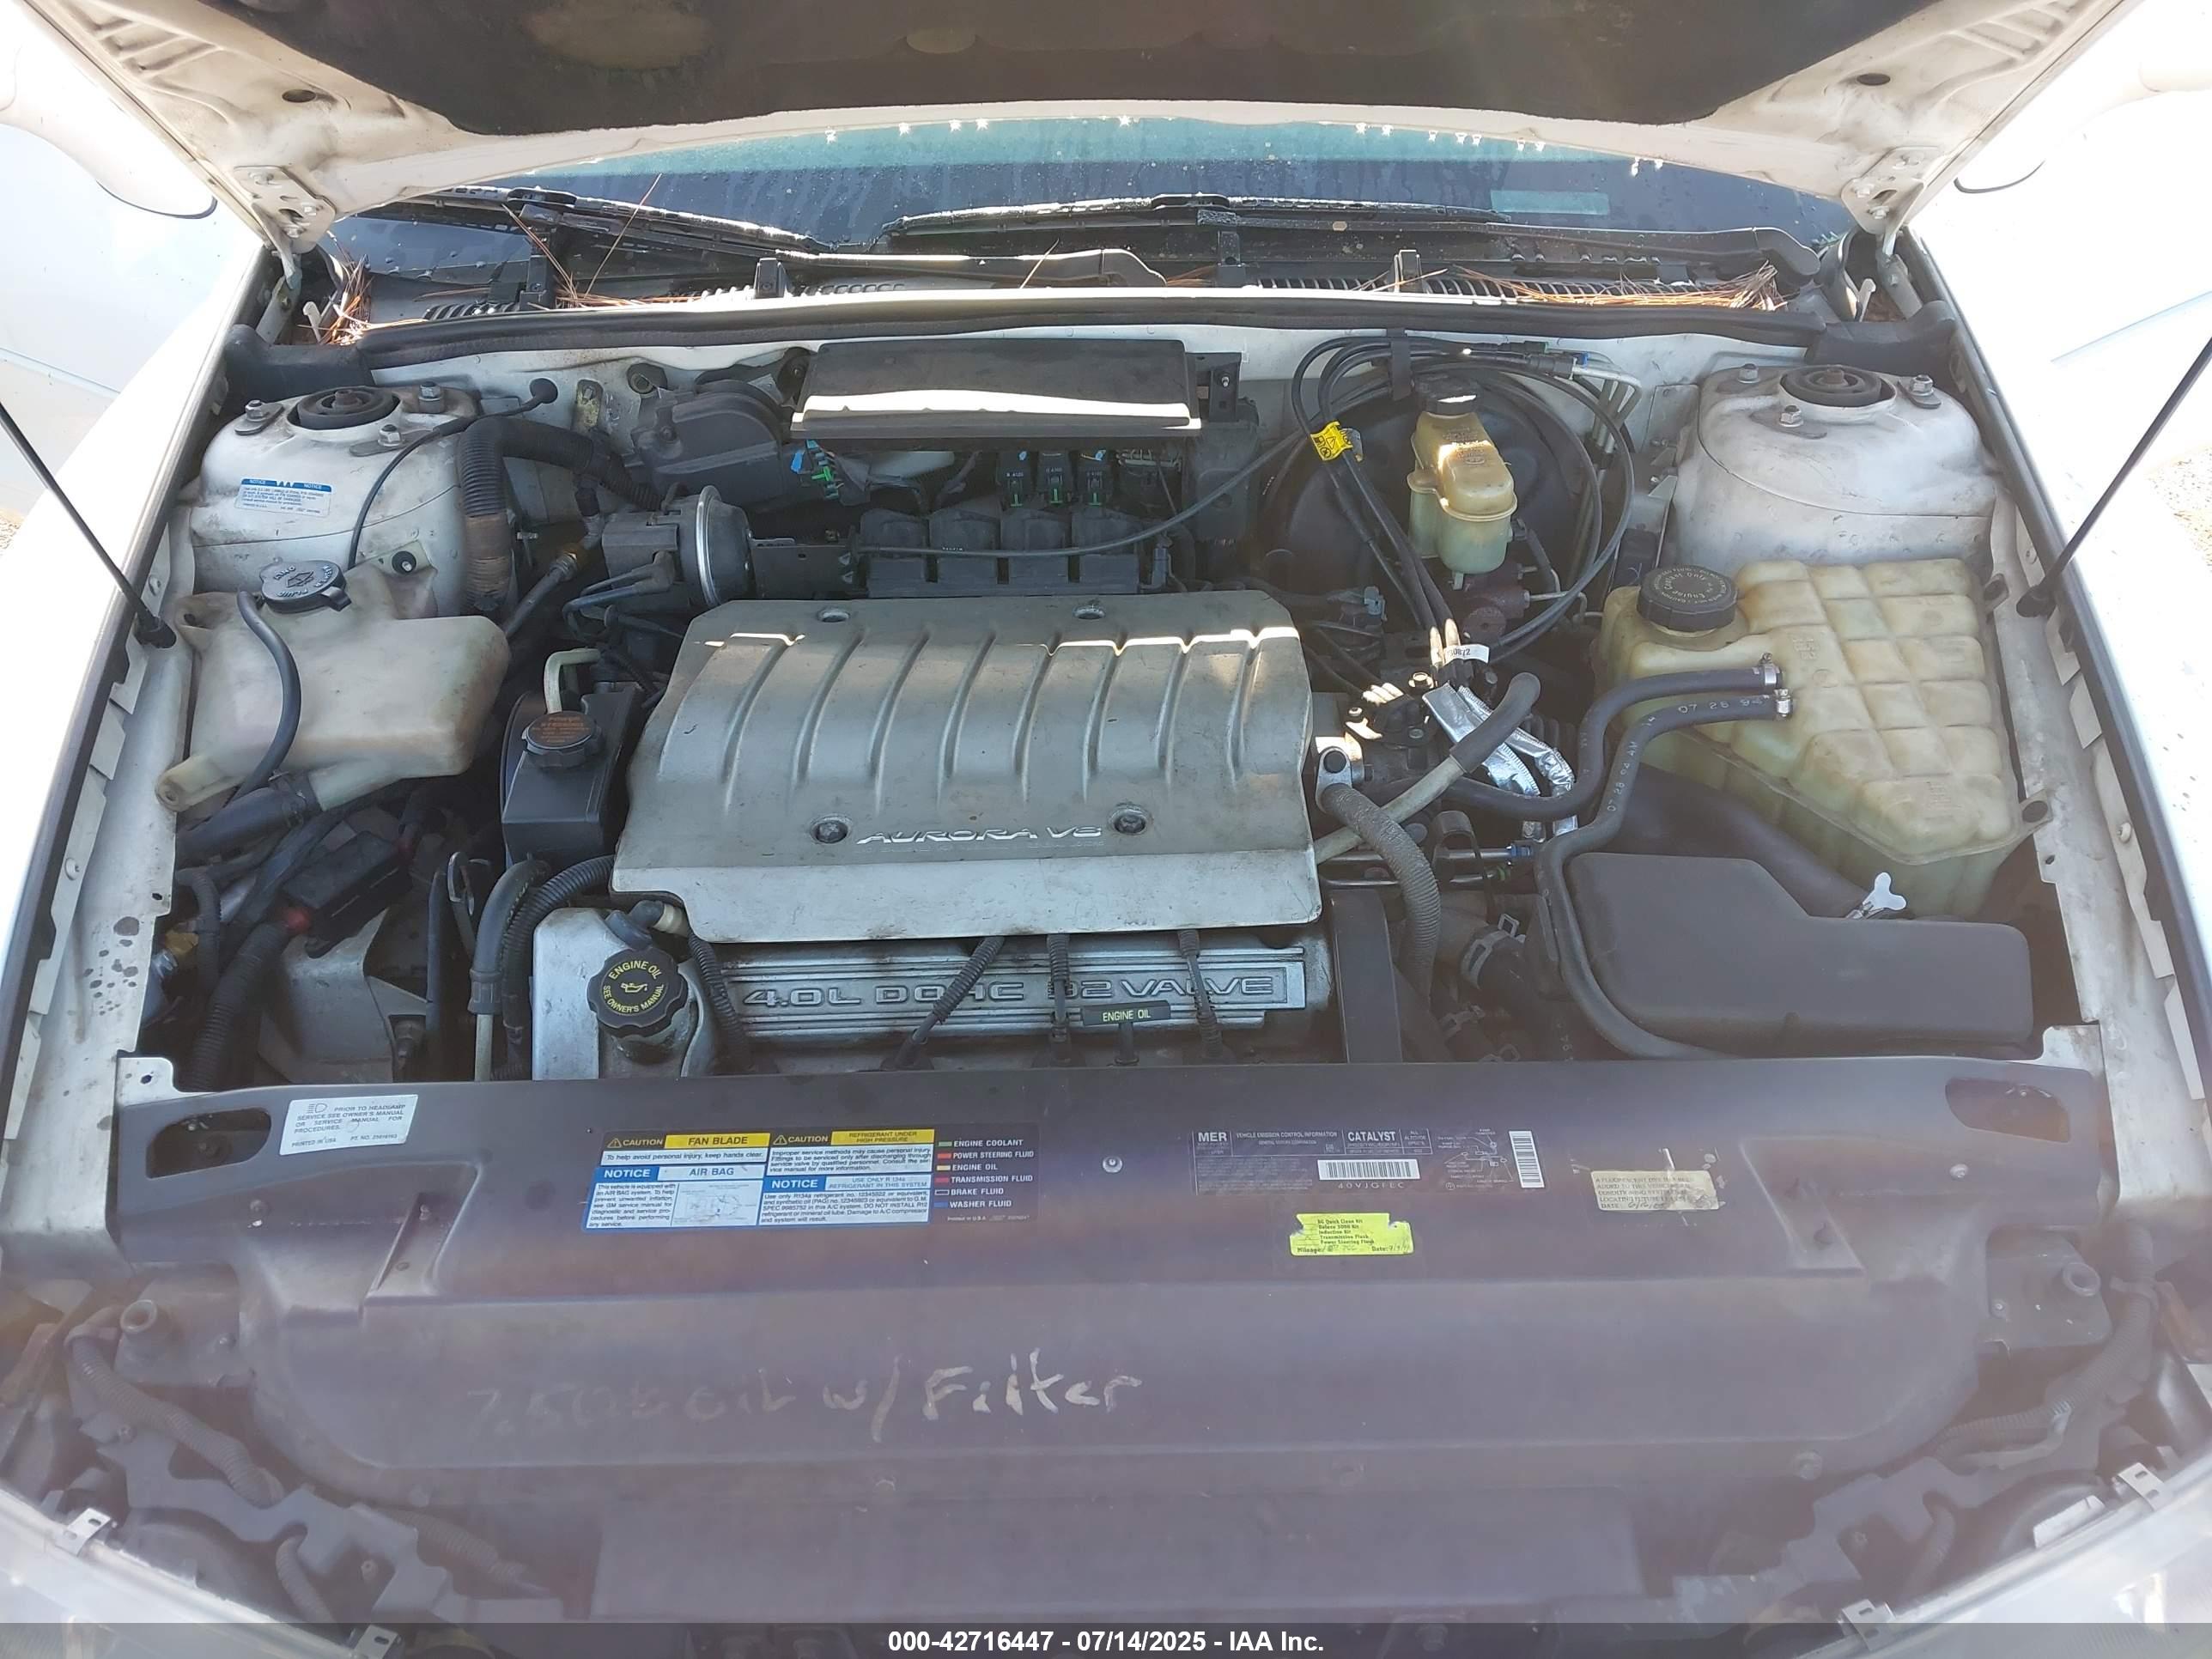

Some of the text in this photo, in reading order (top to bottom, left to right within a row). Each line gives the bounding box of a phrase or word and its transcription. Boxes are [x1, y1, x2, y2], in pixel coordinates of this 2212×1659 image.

[1678, 704, 1697, 714] 07
[856, 826, 1103, 845] AURORA V8
[608, 960, 663, 981] ENGINE OIL
[603, 984, 665, 1013] SEE OWNER'S MANUAL
[742, 987, 862, 1008] 4.0L
[1103, 1008, 1151, 1022] ENGINE OIL
[622, 1135, 749, 1147] CAUTION FAN BLADE
[788, 1135, 828, 1144] CAUTION
[1198, 1132, 1228, 1142] MER
[1348, 1131, 1396, 1142] CATALYST
[986, 1139, 1024, 1147] COOLANT
[980, 1151, 1012, 1159] STEERING
[951, 1163, 982, 1171] ENGINE
[604, 1169, 652, 1178] NOTICE
[689, 1168, 735, 1176] AIR BAG
[771, 1179, 818, 1188] NOTICE
[951, 1175, 1009, 1183] TRANSMISSION
[950, 1200, 986, 1209] WASHER
[921, 1349, 1146, 1422] Filter
